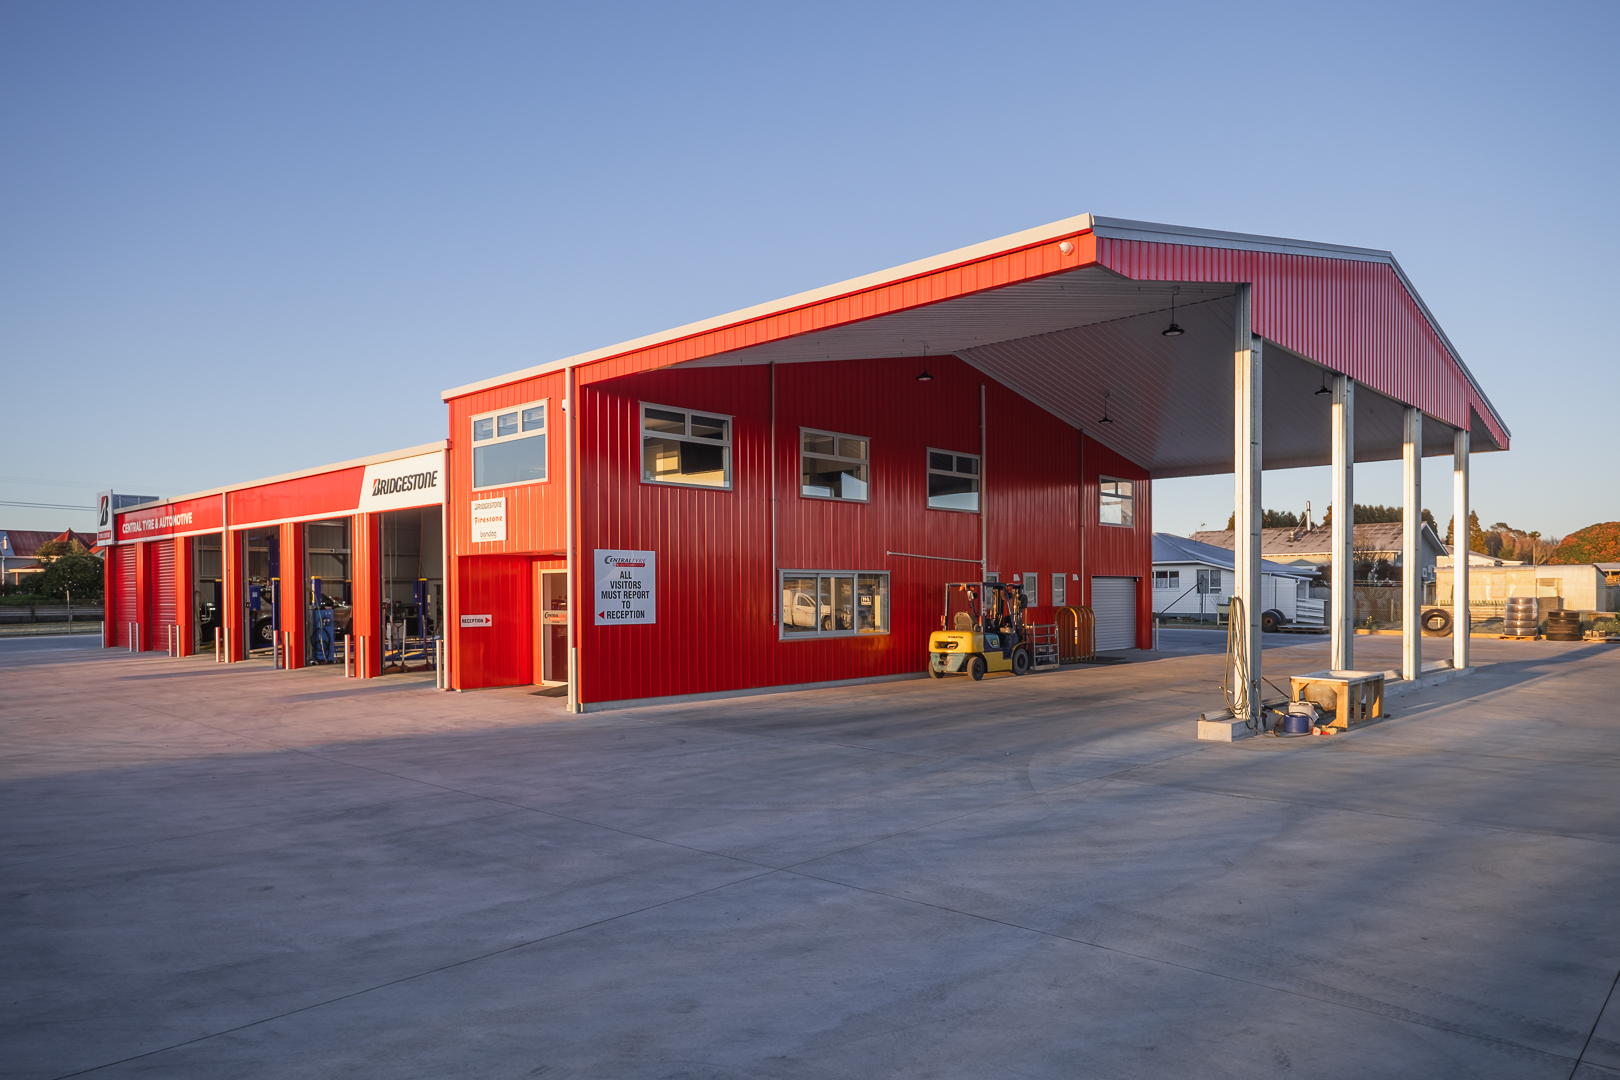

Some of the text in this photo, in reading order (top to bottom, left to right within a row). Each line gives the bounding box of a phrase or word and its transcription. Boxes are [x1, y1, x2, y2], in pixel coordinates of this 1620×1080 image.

[372, 470, 438, 496] BRIDGESTONE
[122, 521, 142, 534] CENTRAL
[142, 518, 155, 531] TYRE
[159, 512, 193, 529] AUTOMOTIVE
[474, 515, 503, 525] Firestone
[619, 570, 633, 580] ALL
[610, 580, 642, 590] VISITORS
[601, 590, 650, 600] MUST REPORT
[621, 600, 631, 609] TO
[606, 610, 645, 619] RECEPTION
